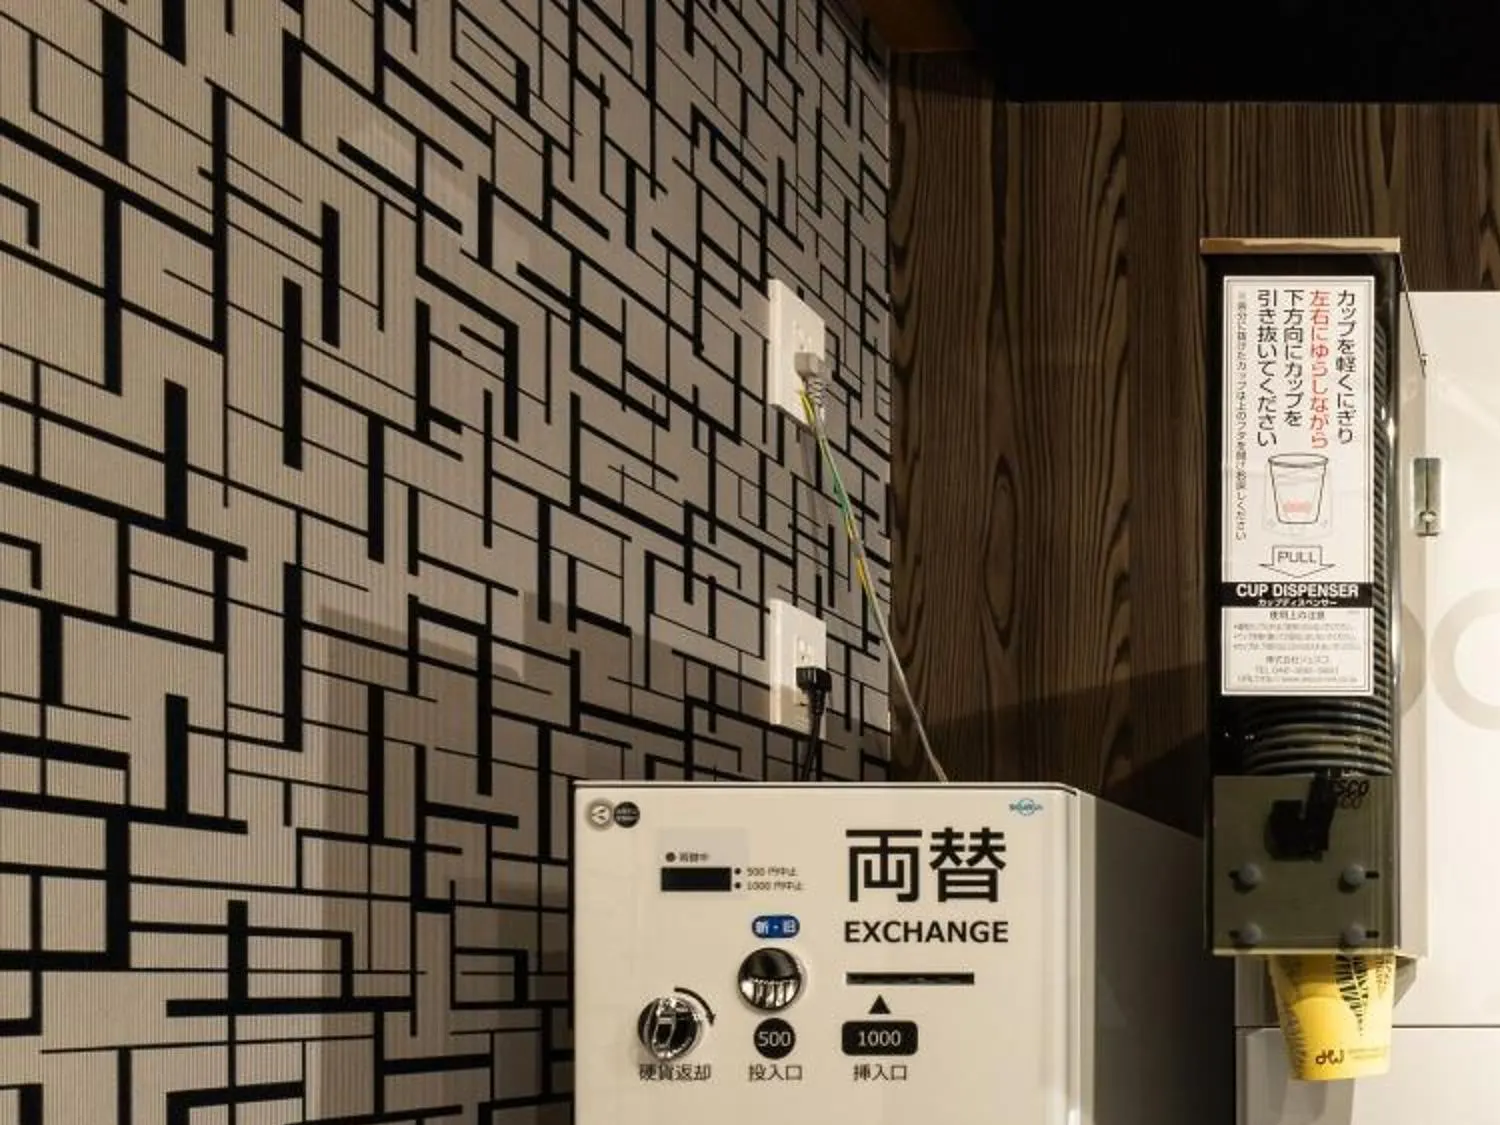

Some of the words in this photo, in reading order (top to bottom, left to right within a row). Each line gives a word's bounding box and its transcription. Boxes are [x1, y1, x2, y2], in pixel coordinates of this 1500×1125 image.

[1283, 289, 1304, 427] 下方向にカップを
[1257, 289, 1278, 447] 引き抜いてください
[1310, 289, 1331, 449] 左右にゆらしながら
[1336, 290, 1357, 445] カップを軽くにぎり
[1277, 551, 1317, 564] PULL
[1236, 583, 1269, 598] CUP
[1272, 583, 1359, 598] DISPENSER
[844, 826, 1008, 904] 両替
[844, 920, 1009, 944] EXCHANGE
[758, 1031, 791, 1047] 500
[857, 1031, 901, 1047] 1000
[639, 1063, 712, 1081] 硬貨返却
[749, 1064, 803, 1081] 投入口
[853, 1064, 908, 1081] 挿入口
